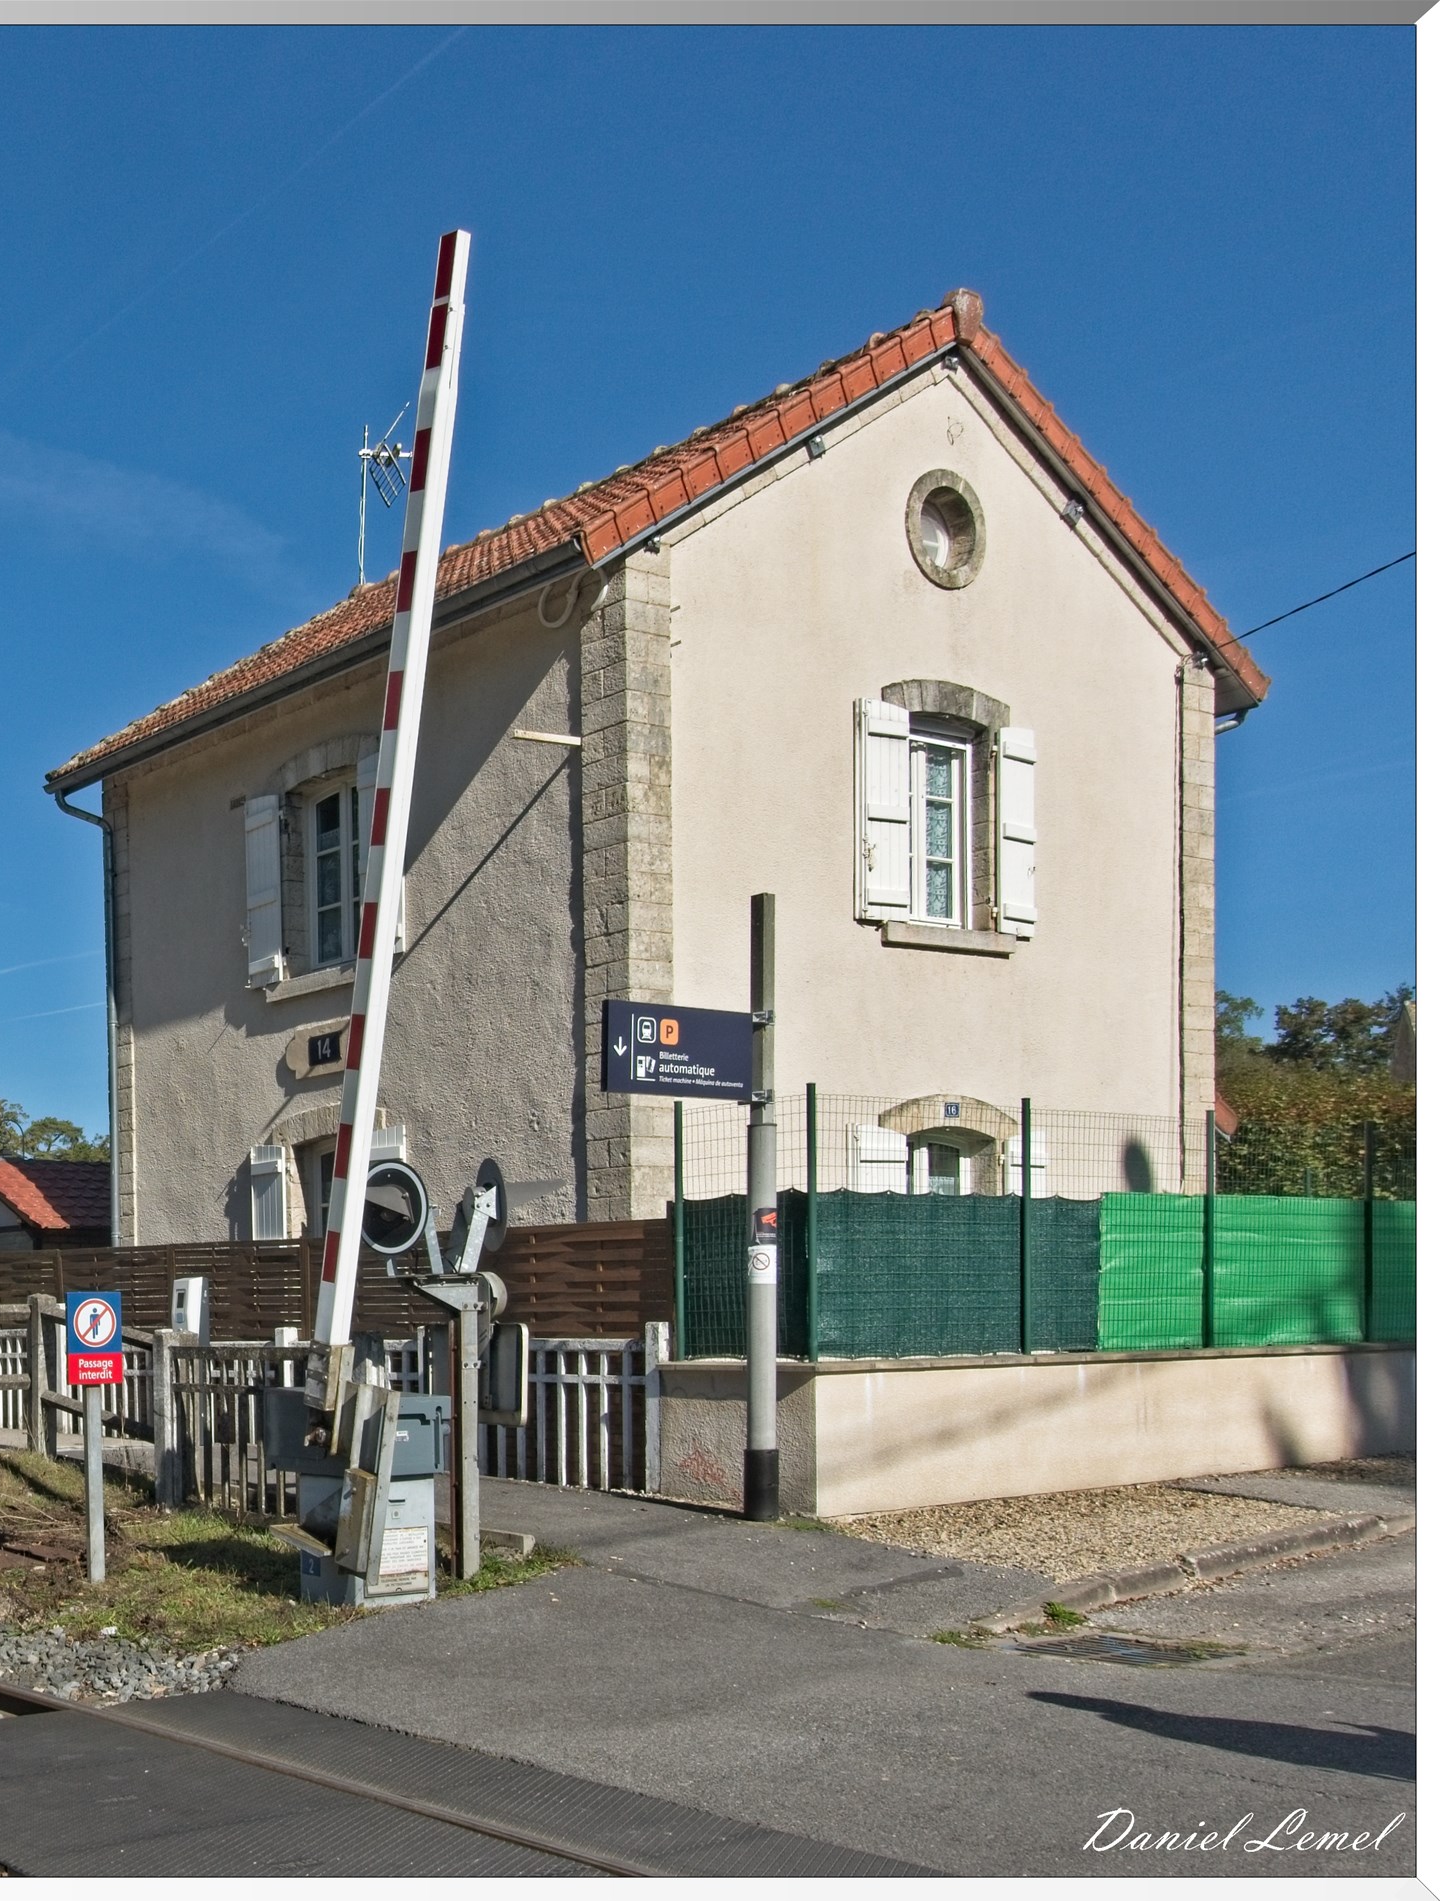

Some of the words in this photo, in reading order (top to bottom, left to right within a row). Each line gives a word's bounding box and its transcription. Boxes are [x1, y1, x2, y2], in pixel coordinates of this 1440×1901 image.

[665, 1025, 674, 1039] P
[317, 1038, 331, 1060] 14
[659, 1051, 689, 1062] Billetterie
[659, 1063, 715, 1078] automatique
[659, 1075, 673, 1084] Ticket
[947, 1105, 957, 1116] 16
[78, 1359, 113, 1370] Passage
[79, 1369, 113, 1380] interdit
[309, 1558, 314, 1574] 2
